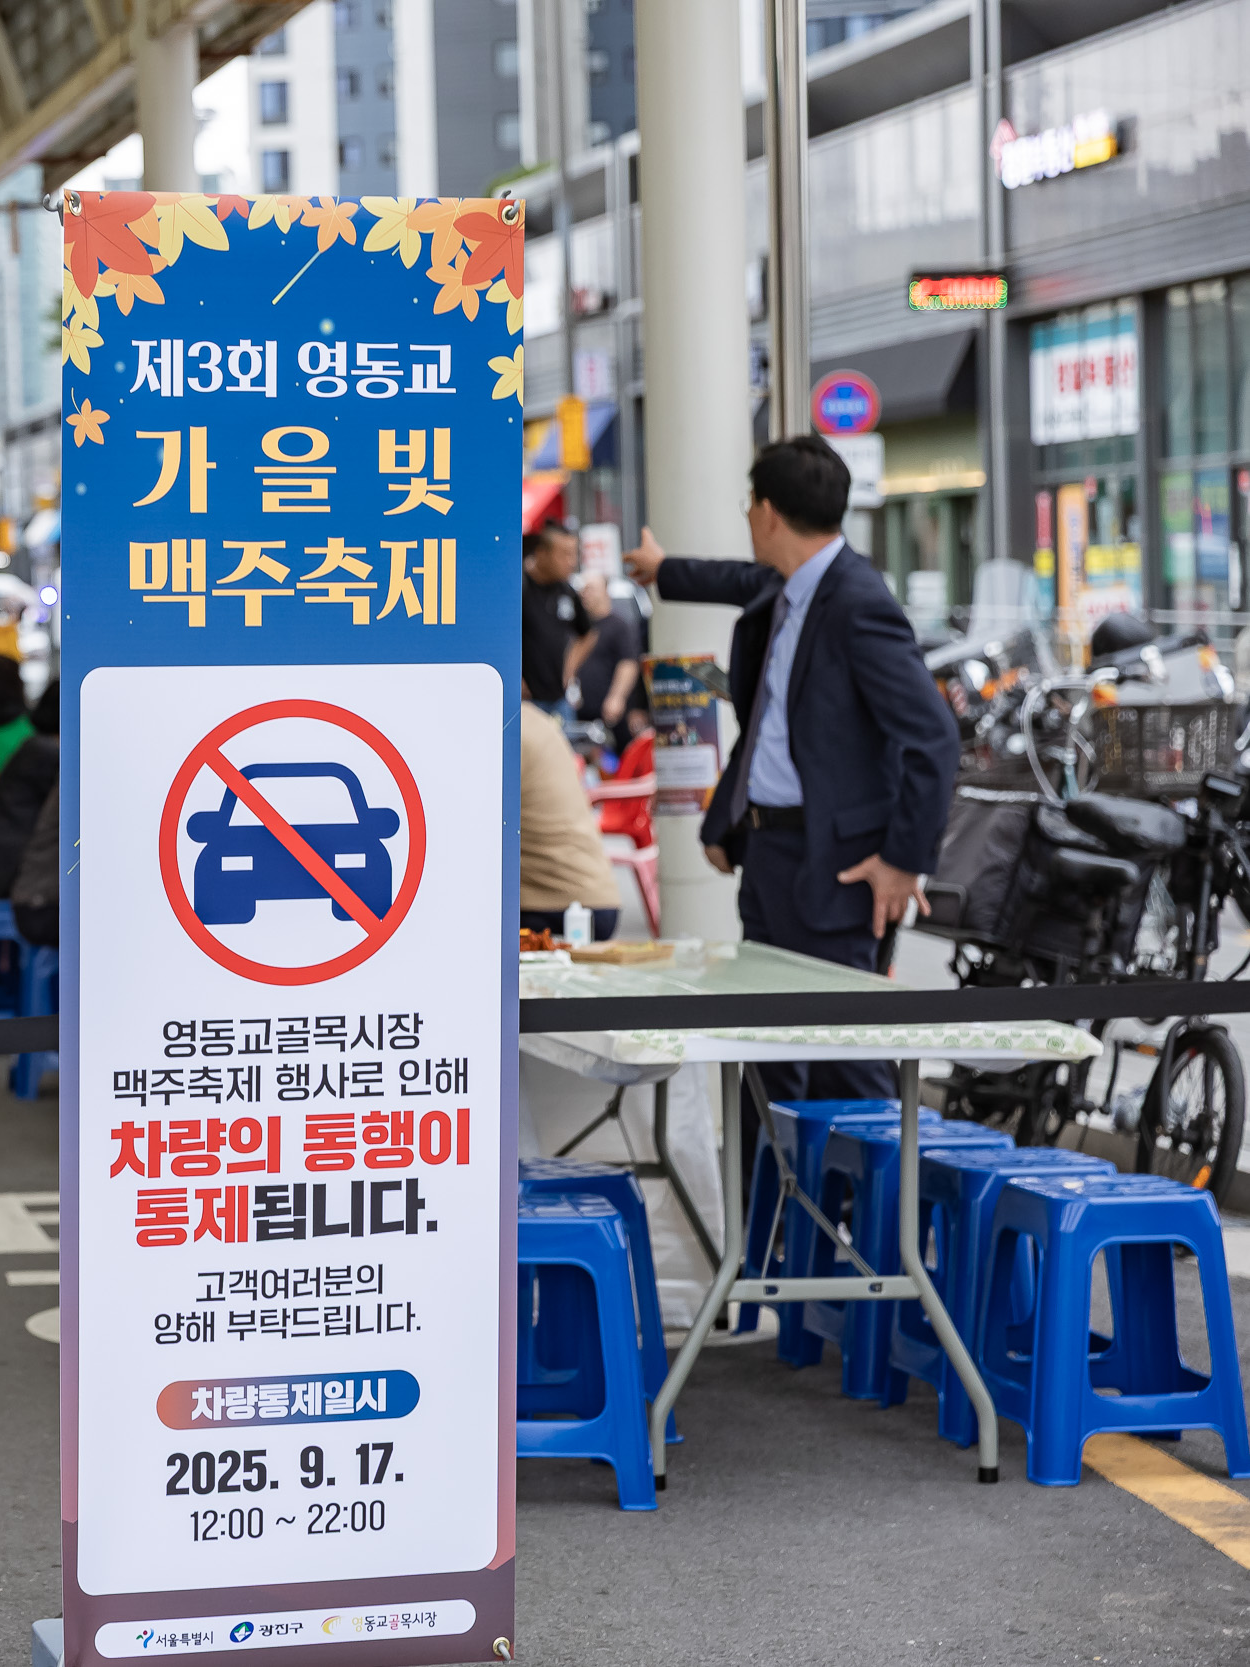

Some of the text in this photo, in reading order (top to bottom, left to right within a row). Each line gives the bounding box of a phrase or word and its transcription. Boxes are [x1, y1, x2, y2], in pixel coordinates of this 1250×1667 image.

[130, 339, 456, 399] 제3회 영동교
[130, 538, 456, 627] 맥주축제
[163, 1013, 423, 1057] 영동교골목시장
[114, 1058, 468, 1106] 맥주축제 행사로 인해
[110, 1108, 470, 1178] 차량의 통행이
[135, 1178, 438, 1247] 통제됩니다.
[196, 1264, 383, 1302] 고객여러분의
[154, 1302, 421, 1344] 양해 부탁드립니다.
[191, 1379, 387, 1421] 차량통제일시
[166, 1443, 404, 1495] 2025. 9. 17.
[190, 1508, 264, 1541] 12:00
[307, 1501, 385, 1534] 22:00
[156, 1630, 214, 1648] 서울특별시
[259, 1622, 304, 1636] 광진구
[352, 1611, 437, 1632] 영동교골목시장
